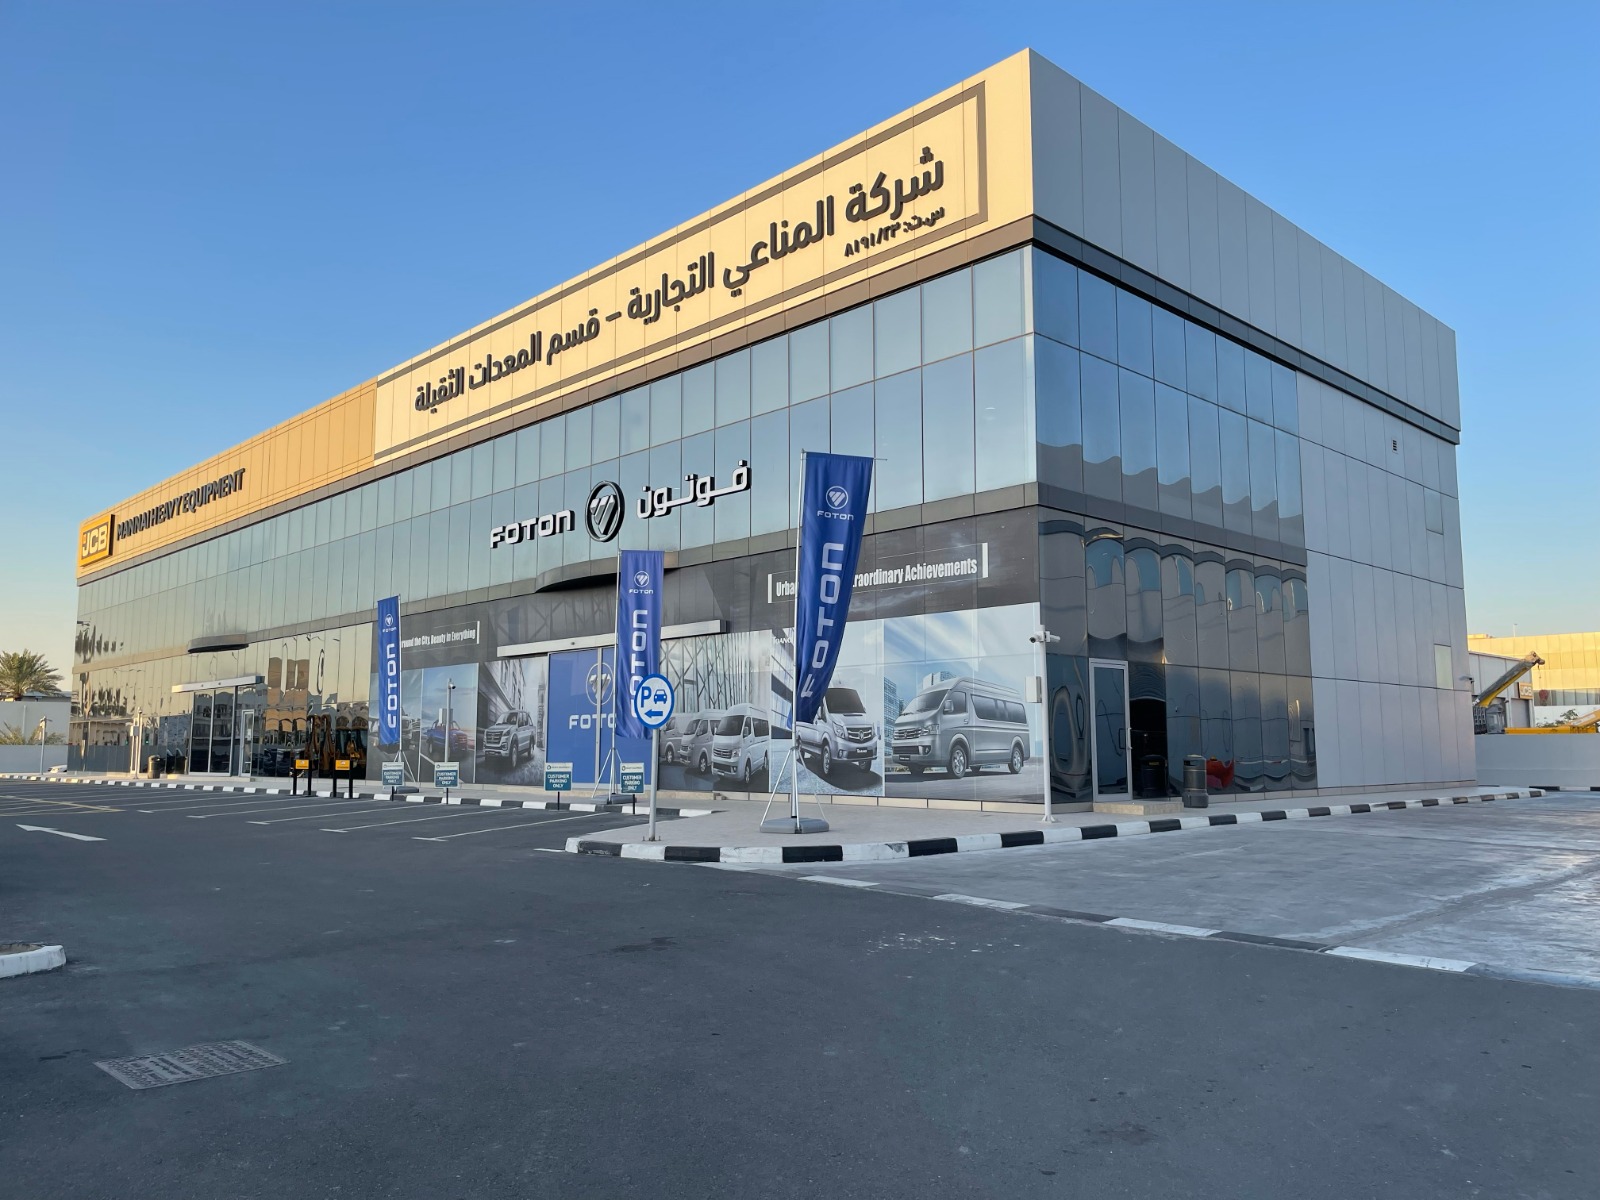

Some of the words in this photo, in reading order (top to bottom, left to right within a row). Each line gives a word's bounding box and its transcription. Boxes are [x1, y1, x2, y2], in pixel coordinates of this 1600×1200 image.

[845, 146, 945, 223] شركة
[722, 195, 835, 298] المناعي
[627, 251, 715, 325] التجارية
[468, 331, 542, 391] المعدات
[546, 308, 600, 366] قسم
[414, 366, 465, 414] الثقيلة
[116, 510, 151, 542] MANNAI
[150, 496, 184, 527] HEAVY
[181, 467, 246, 514] EQUIPMENT
[636, 459, 752, 519] فوتون
[816, 510, 855, 521] FOTON
[82, 524, 108, 558] JCB
[489, 509, 575, 549] FOTON
[776, 581, 797, 597] Urba
[852, 568, 905, 588] raordinary
[905, 558, 978, 582] Achievements
[451, 629, 476, 641] Everything
[801, 541, 845, 698] FOTON
[569, 713, 617, 730] FOTO
[640, 686, 652, 708] P
